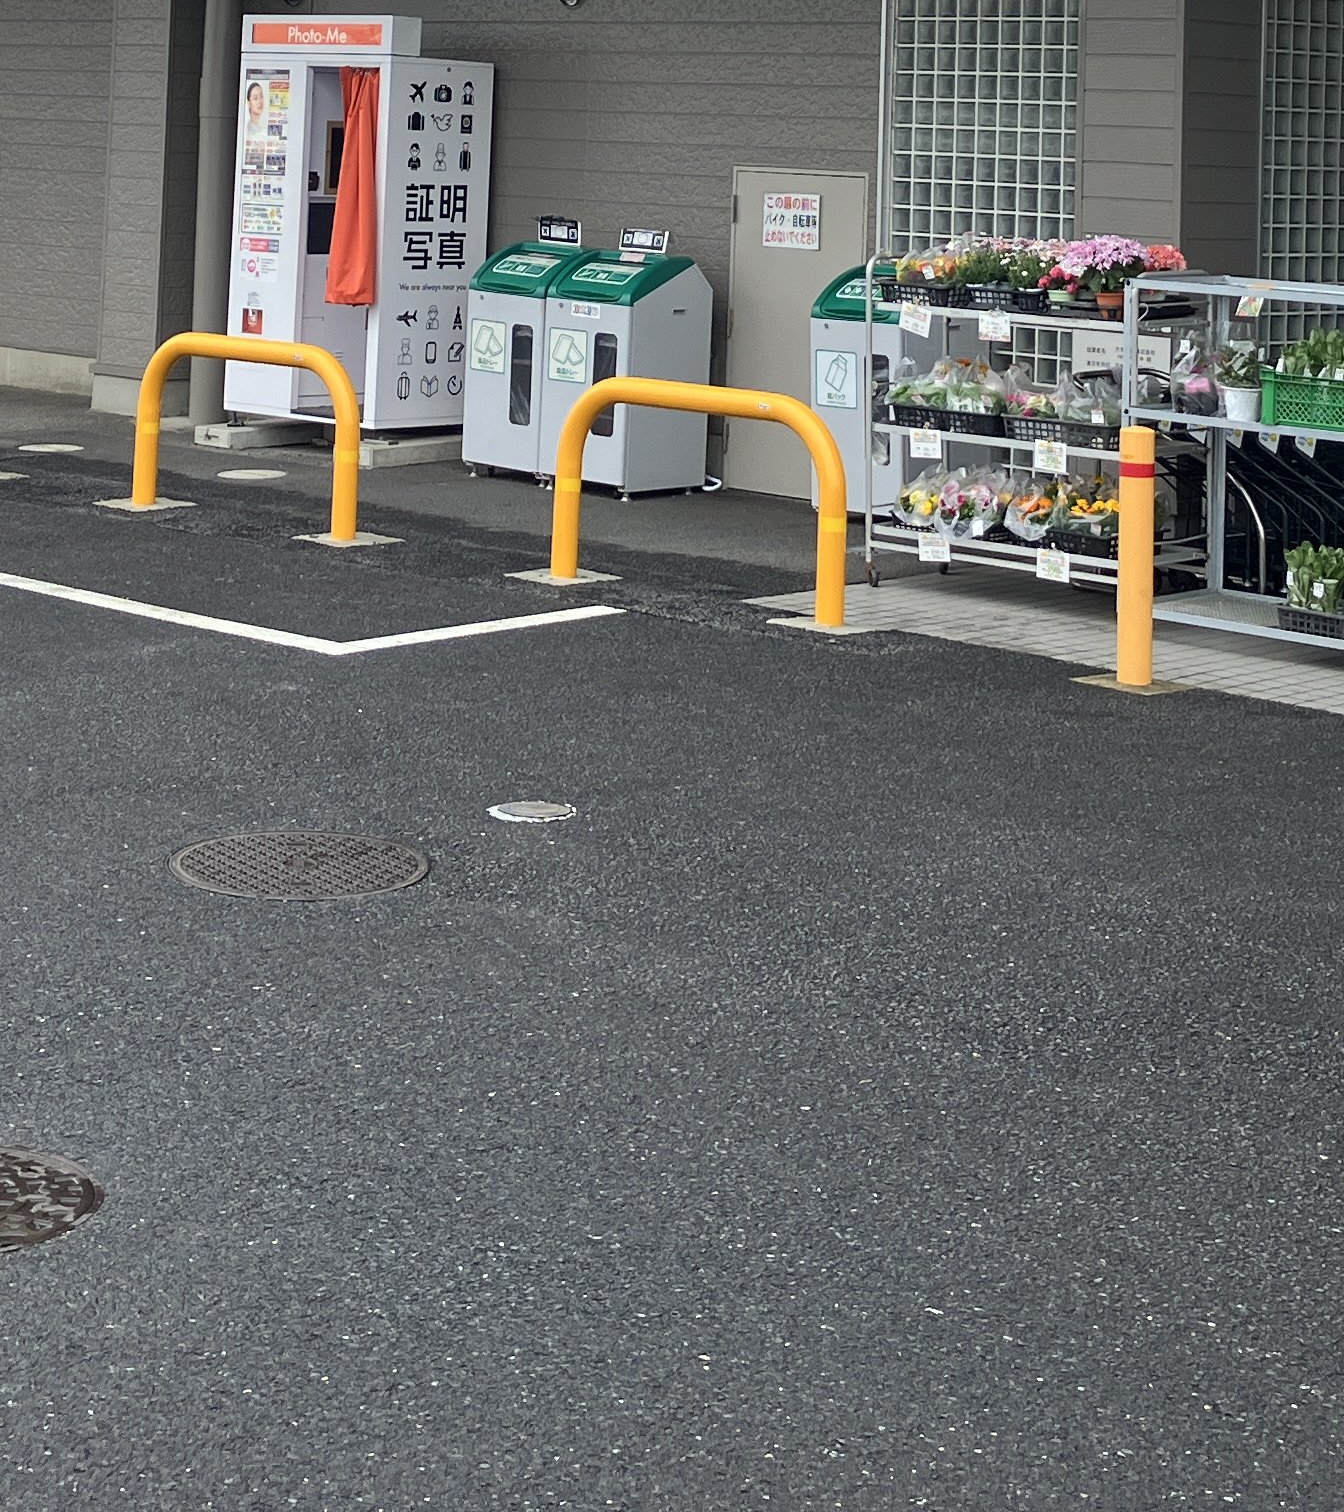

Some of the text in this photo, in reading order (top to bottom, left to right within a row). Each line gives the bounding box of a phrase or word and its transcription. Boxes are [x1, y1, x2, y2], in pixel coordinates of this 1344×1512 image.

[287, 25, 347, 44] Photo-Me
[405, 183, 468, 223] 証明
[403, 231, 467, 270] 写真
